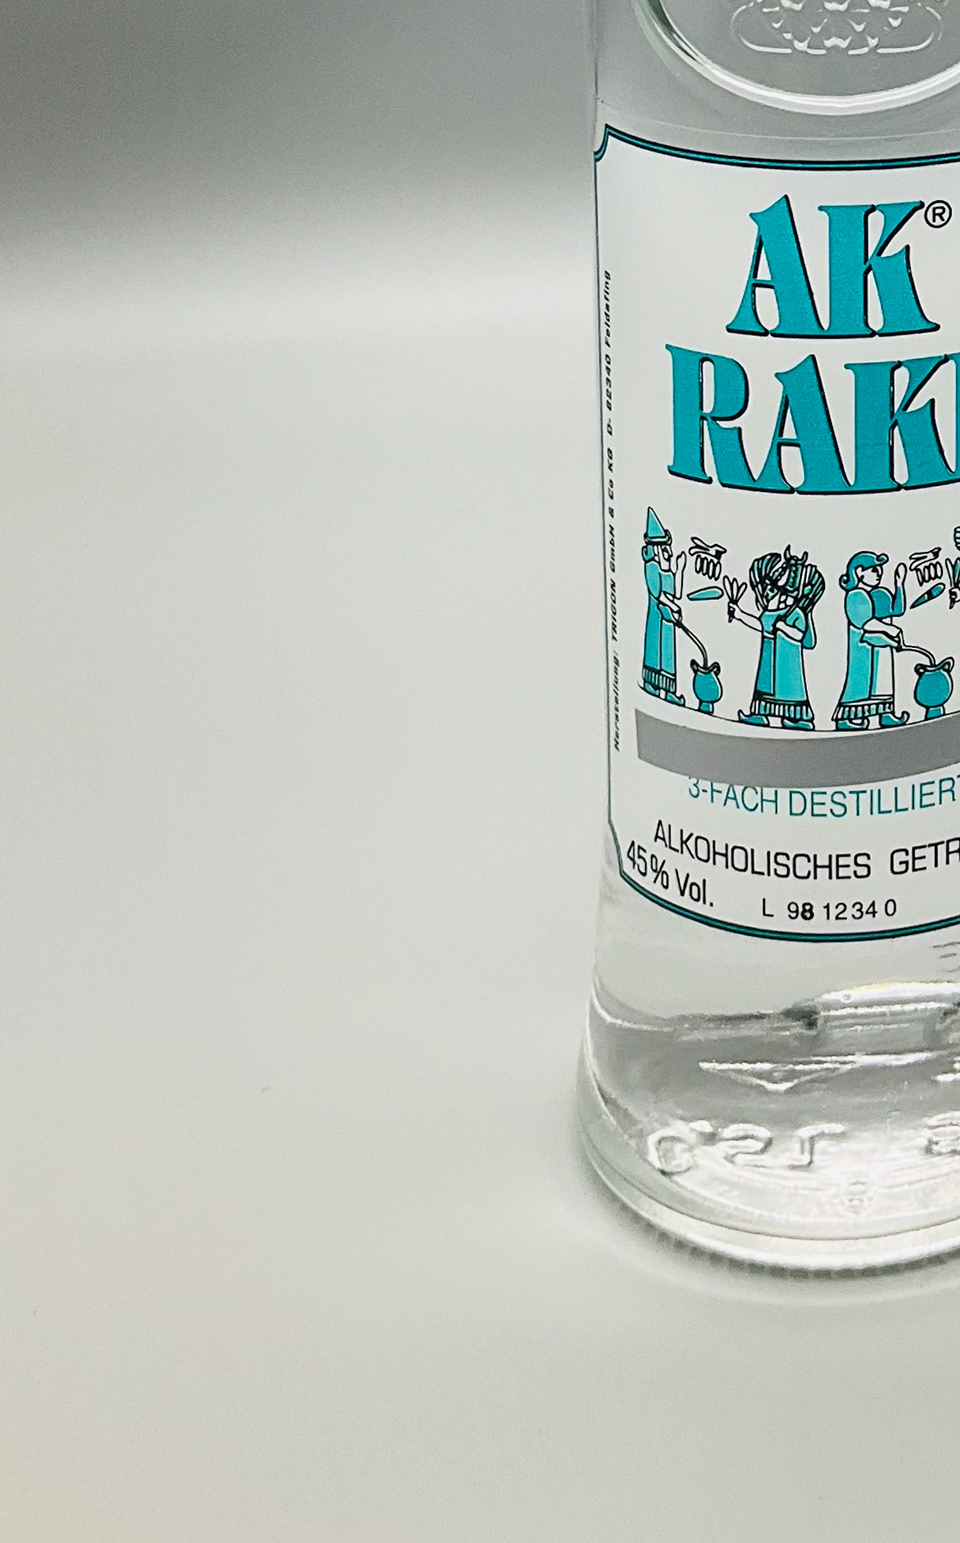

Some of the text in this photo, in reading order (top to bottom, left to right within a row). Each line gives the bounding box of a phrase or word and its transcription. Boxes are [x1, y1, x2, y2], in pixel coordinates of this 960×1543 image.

[603, 269, 612, 348] Feldafing
[606, 447, 614, 473] KG
[608, 524, 616, 573] GmbH
[609, 578, 618, 642] TRIGON
[611, 650, 620, 752] Herstellung:
[687, 774, 779, 815] 3-FACH
[653, 818, 872, 880] ALKOHOLISCHES
[674, 867, 714, 907] Vol.
[762, 897, 775, 918] L
